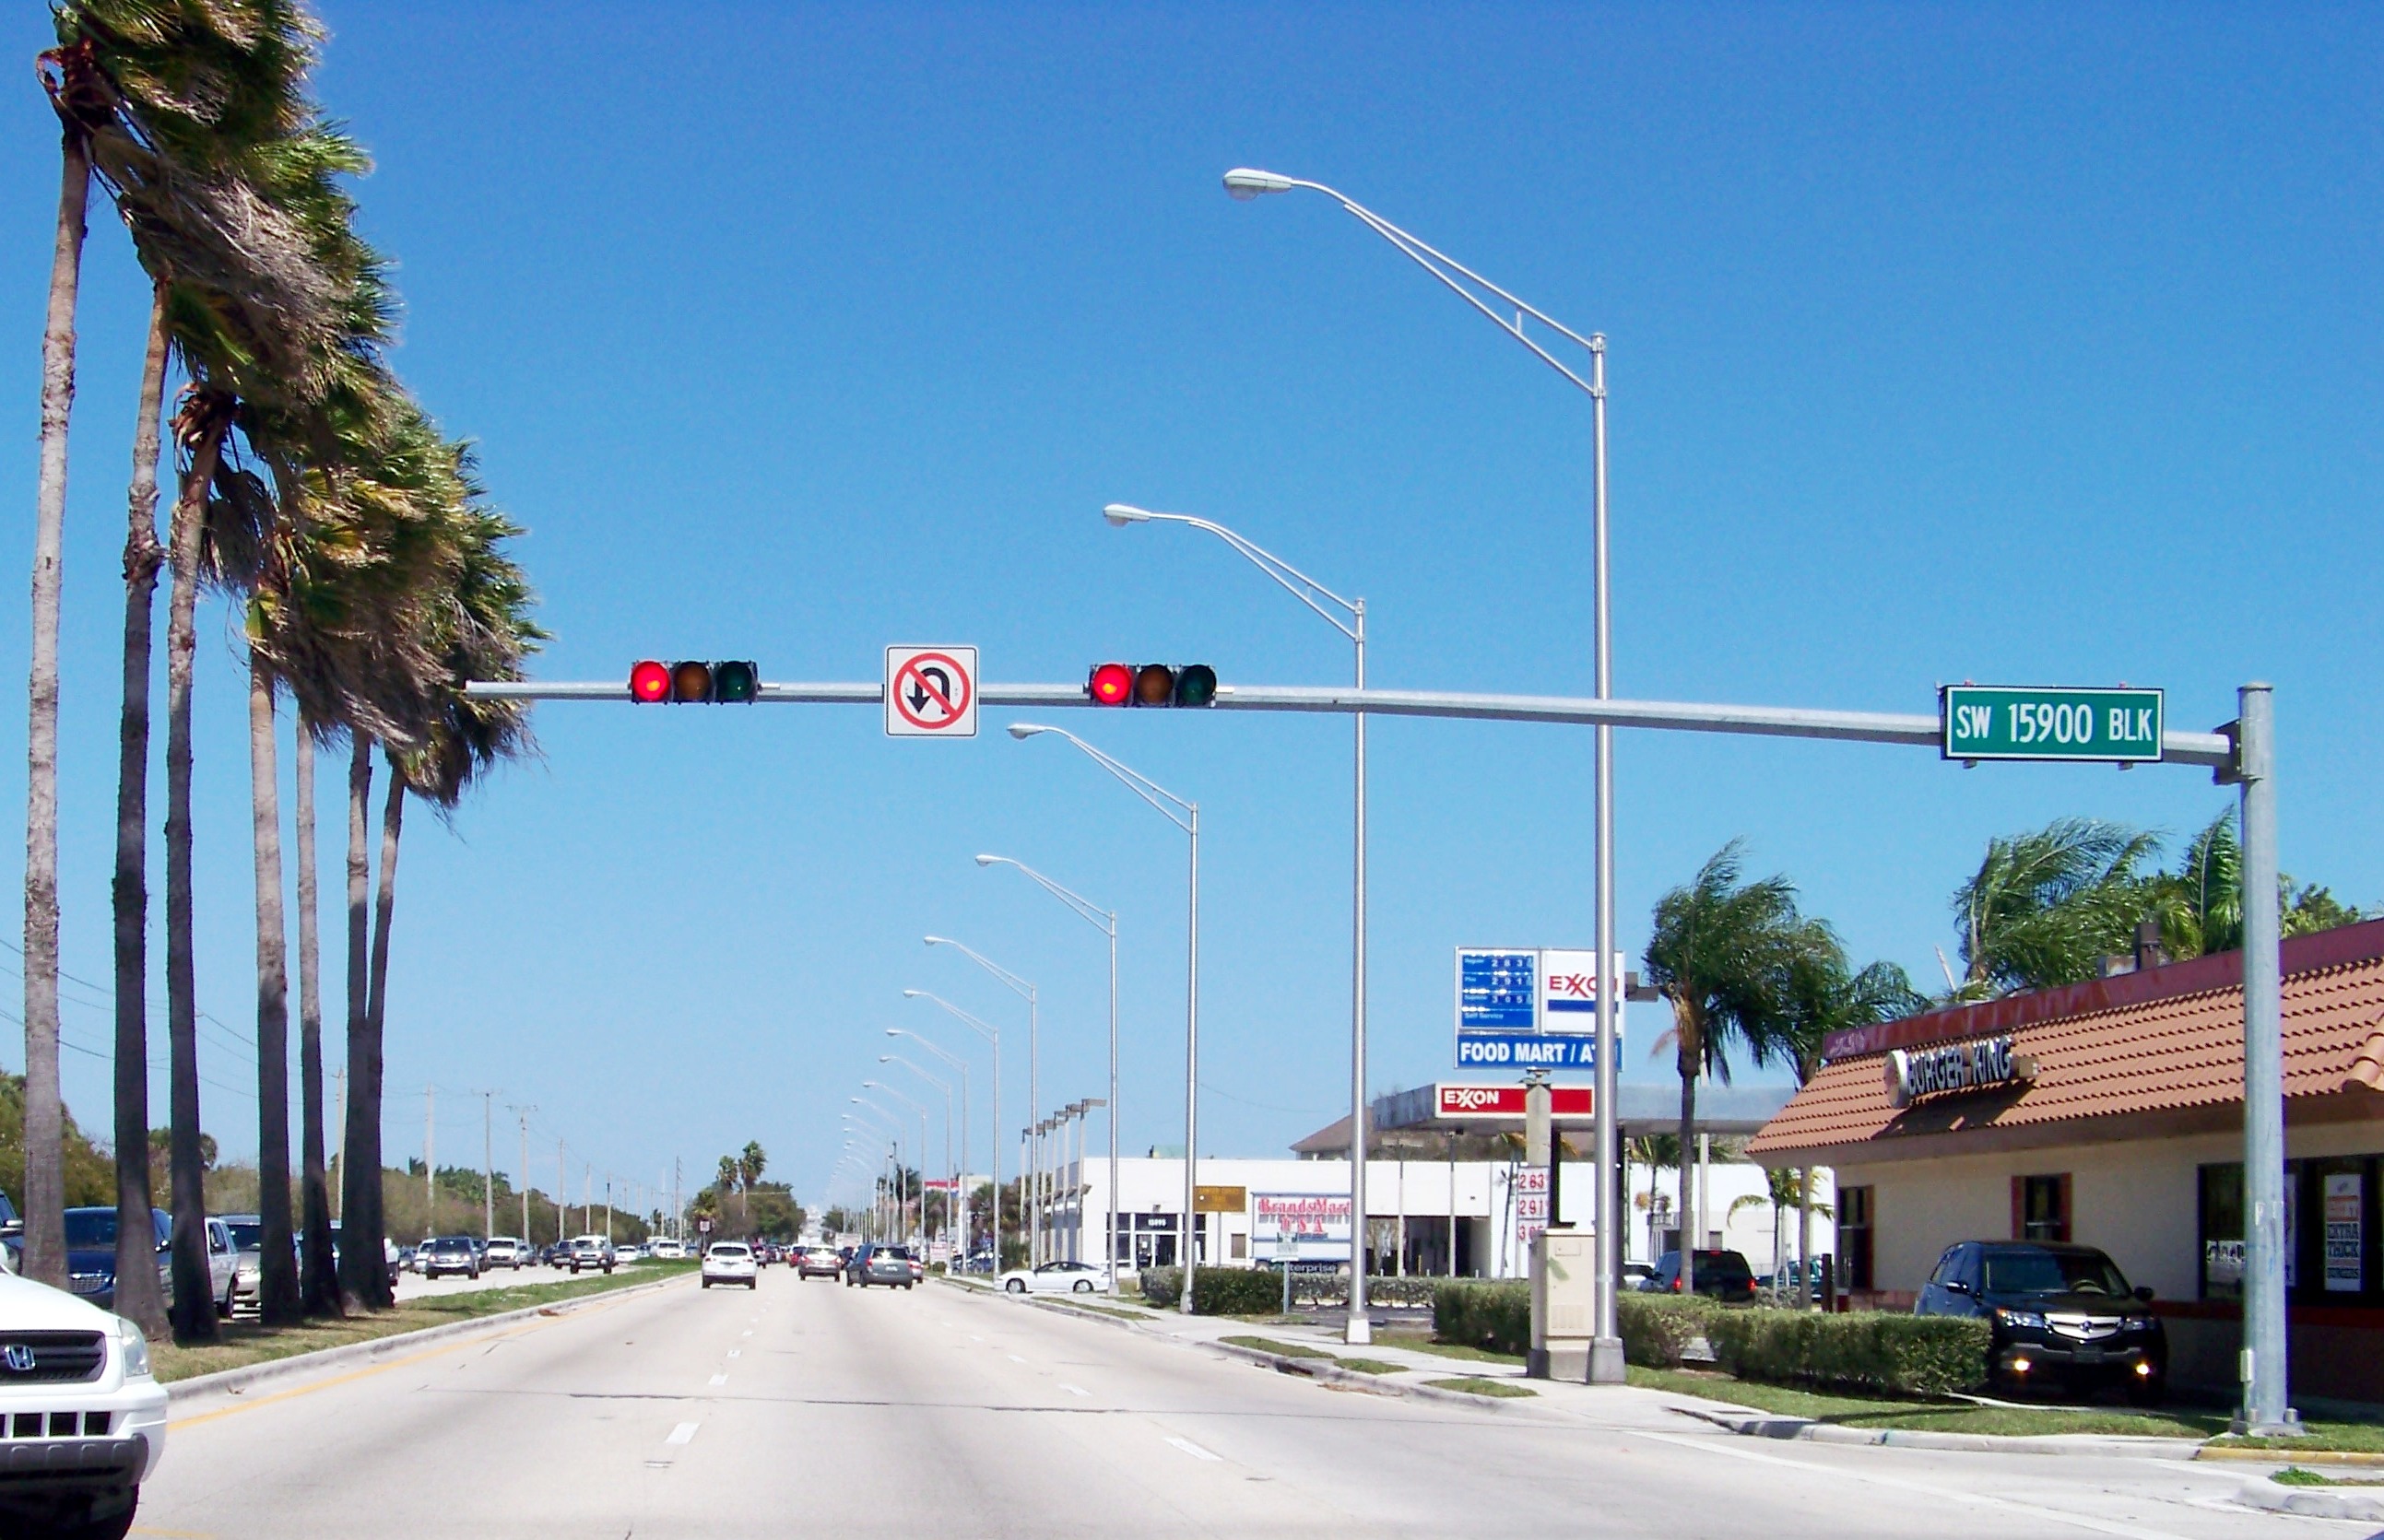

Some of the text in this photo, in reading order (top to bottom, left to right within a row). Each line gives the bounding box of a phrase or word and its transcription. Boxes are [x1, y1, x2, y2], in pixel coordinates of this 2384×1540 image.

[1955, 703, 2153, 744] SW 15900 BLK
[1549, 973, 1618, 998] EXXO
[1460, 1042, 1510, 1062] FOOD
[1515, 1043, 1565, 1063] MART
[1906, 1034, 2012, 1096] BURGER KING
[1444, 1088, 1500, 1109] EXXON
[1519, 1200, 1543, 1216] 291
